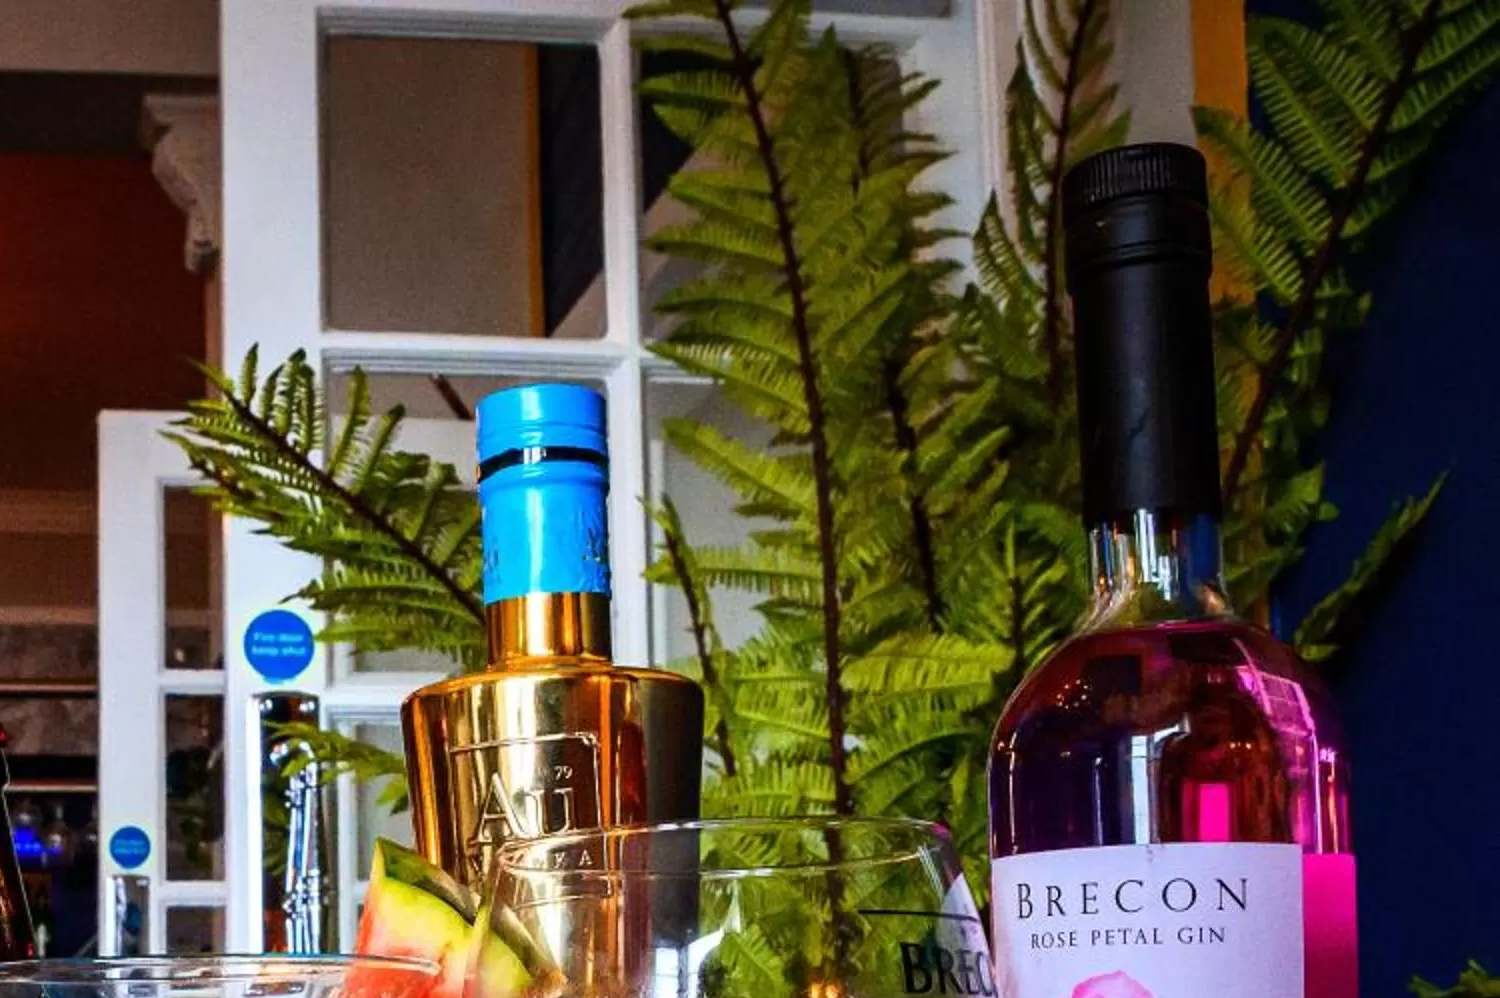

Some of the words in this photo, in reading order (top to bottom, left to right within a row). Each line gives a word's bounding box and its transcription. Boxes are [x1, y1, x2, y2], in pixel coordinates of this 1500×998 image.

[1016, 877, 1251, 920] BRECON
[1030, 931, 1078, 949] ROSE
[1091, 928, 1164, 946] PETAL
[1177, 926, 1227, 945] GIN
